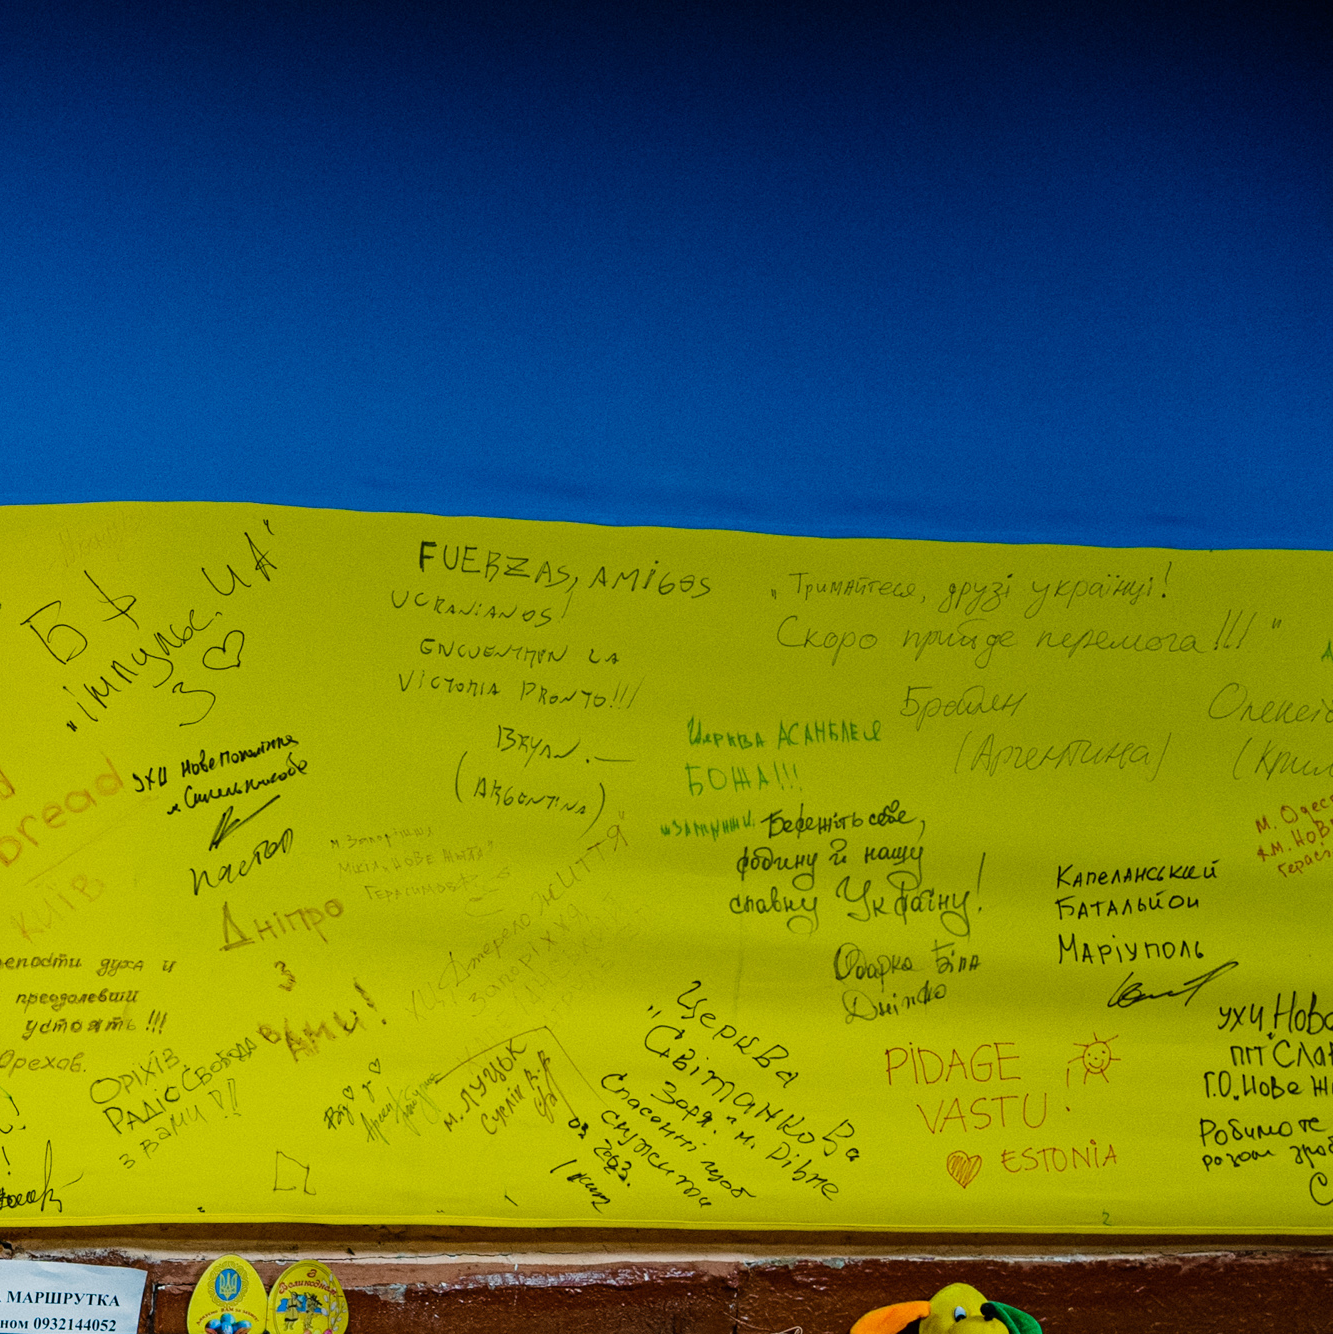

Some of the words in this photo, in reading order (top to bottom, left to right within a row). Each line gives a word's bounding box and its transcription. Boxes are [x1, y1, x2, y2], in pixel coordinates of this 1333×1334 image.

[588, 558, 712, 600] AMIGOS
[884, 1041, 1022, 1087] PIDAGE
[1000, 1138, 1119, 1174] ESTONIA
[6, 1290, 120, 1307] МАРШРУТКА
[33, 1317, 117, 1332] 0932144052
